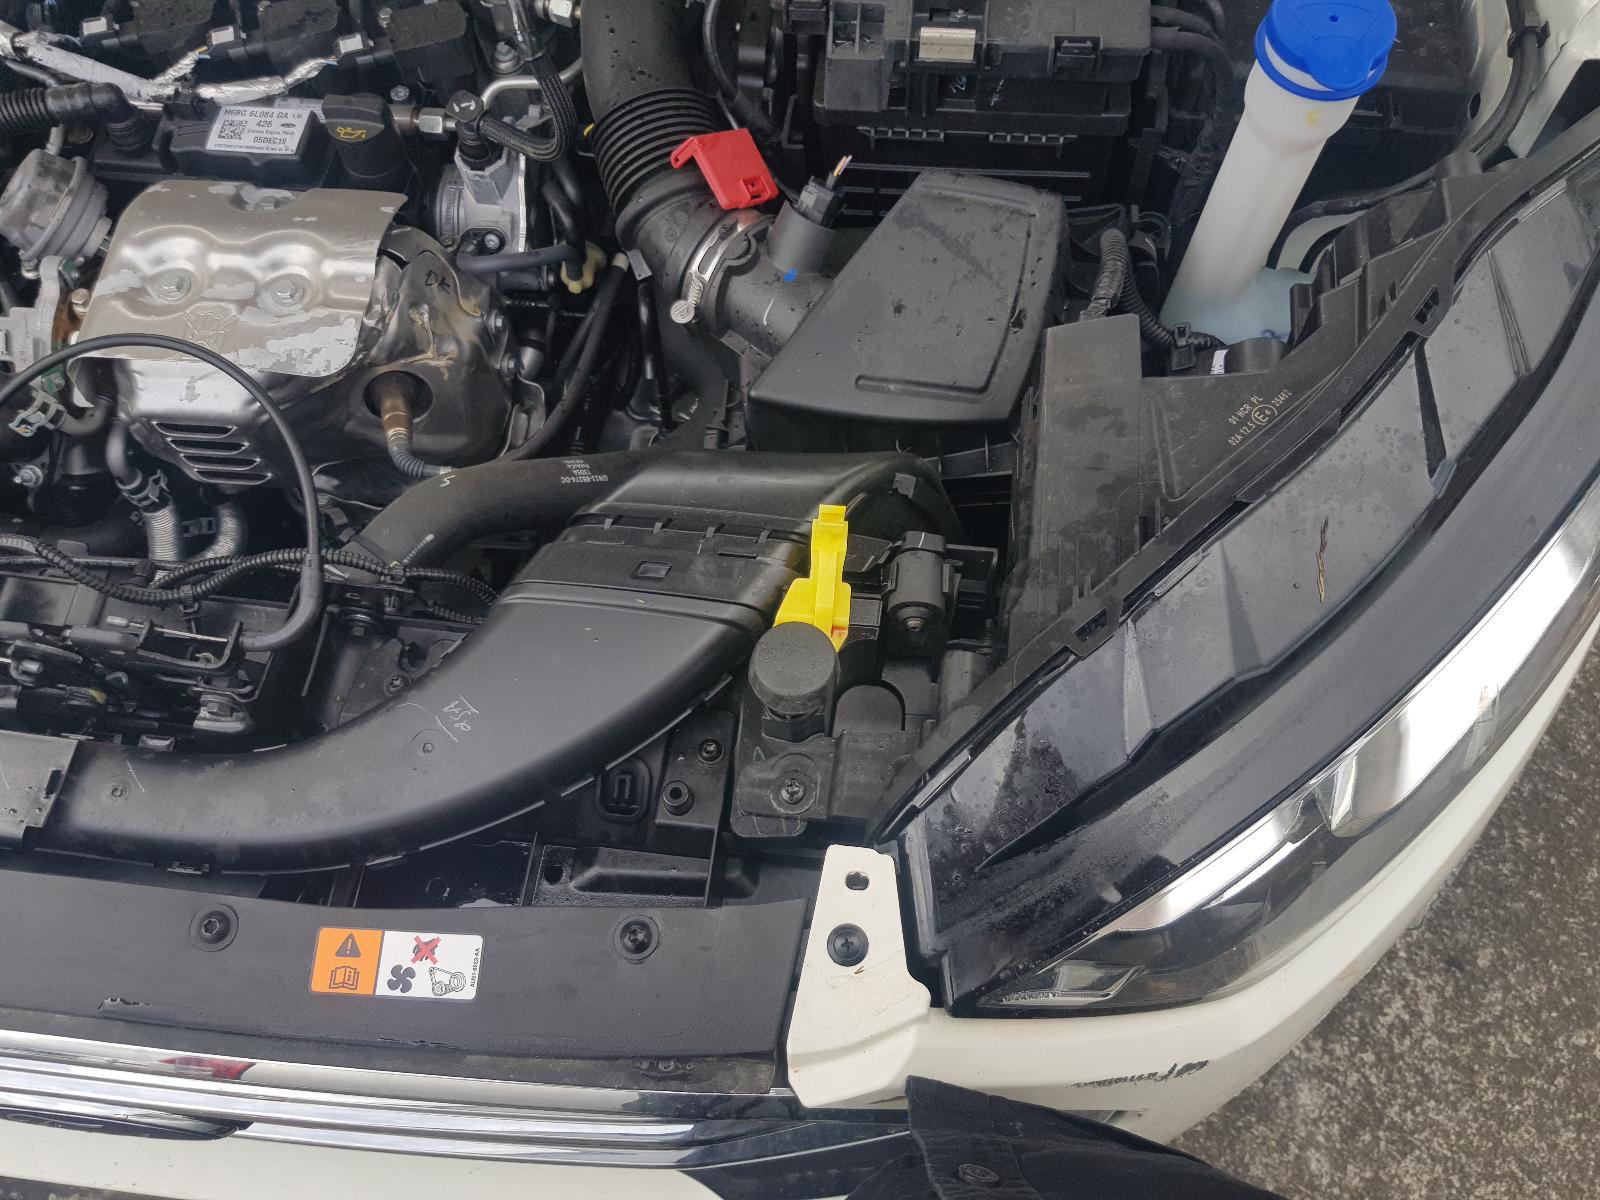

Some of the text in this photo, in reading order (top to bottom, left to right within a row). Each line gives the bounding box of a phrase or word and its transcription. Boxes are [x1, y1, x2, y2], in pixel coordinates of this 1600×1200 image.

[256, 120, 273, 128] 426
[253, 136, 288, 145] 05DEC19
[1251, 395, 1264, 405] PL
